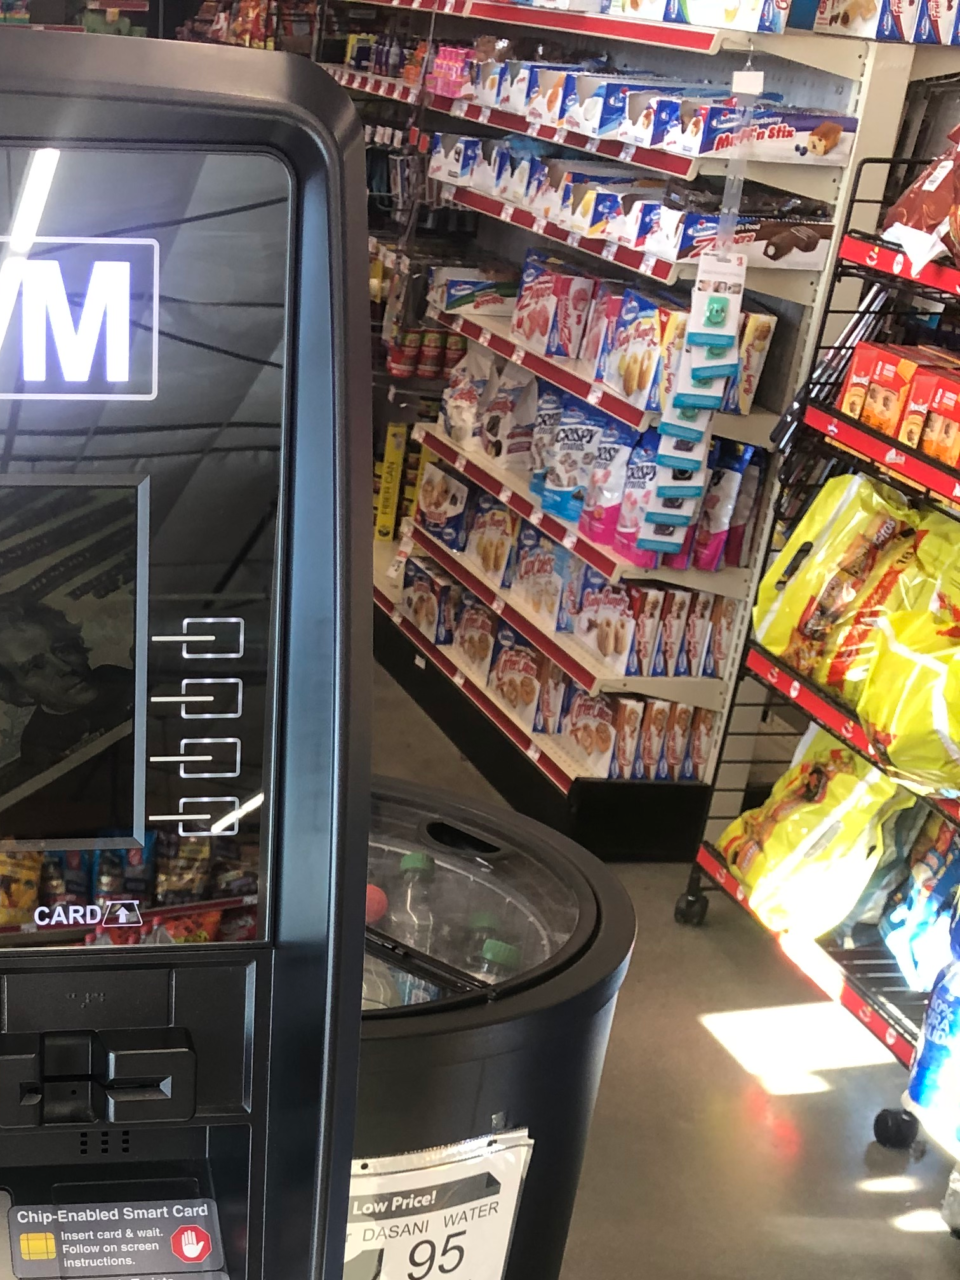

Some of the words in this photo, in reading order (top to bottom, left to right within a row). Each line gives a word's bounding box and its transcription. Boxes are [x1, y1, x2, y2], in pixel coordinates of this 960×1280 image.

[33, 904, 102, 927] CARD
[352, 1200, 389, 1215] Low
[391, 1189, 437, 1212] Price!
[16, 1207, 120, 1226] Chip-Enabled
[123, 1205, 169, 1220] Smart
[172, 1203, 209, 1218] Card
[362, 1219, 430, 1242] DASANI
[442, 1200, 500, 1229] WATER
[60, 1230, 95, 1241] Insert
[96, 1229, 123, 1240] card
[125, 1229, 135, 1239] &
[136, 1227, 164, 1238] wait.
[62, 1243, 100, 1254] Follow
[102, 1245, 118, 1253] on
[120, 1241, 160, 1252] screen
[63, 1257, 136, 1268] instructions.
